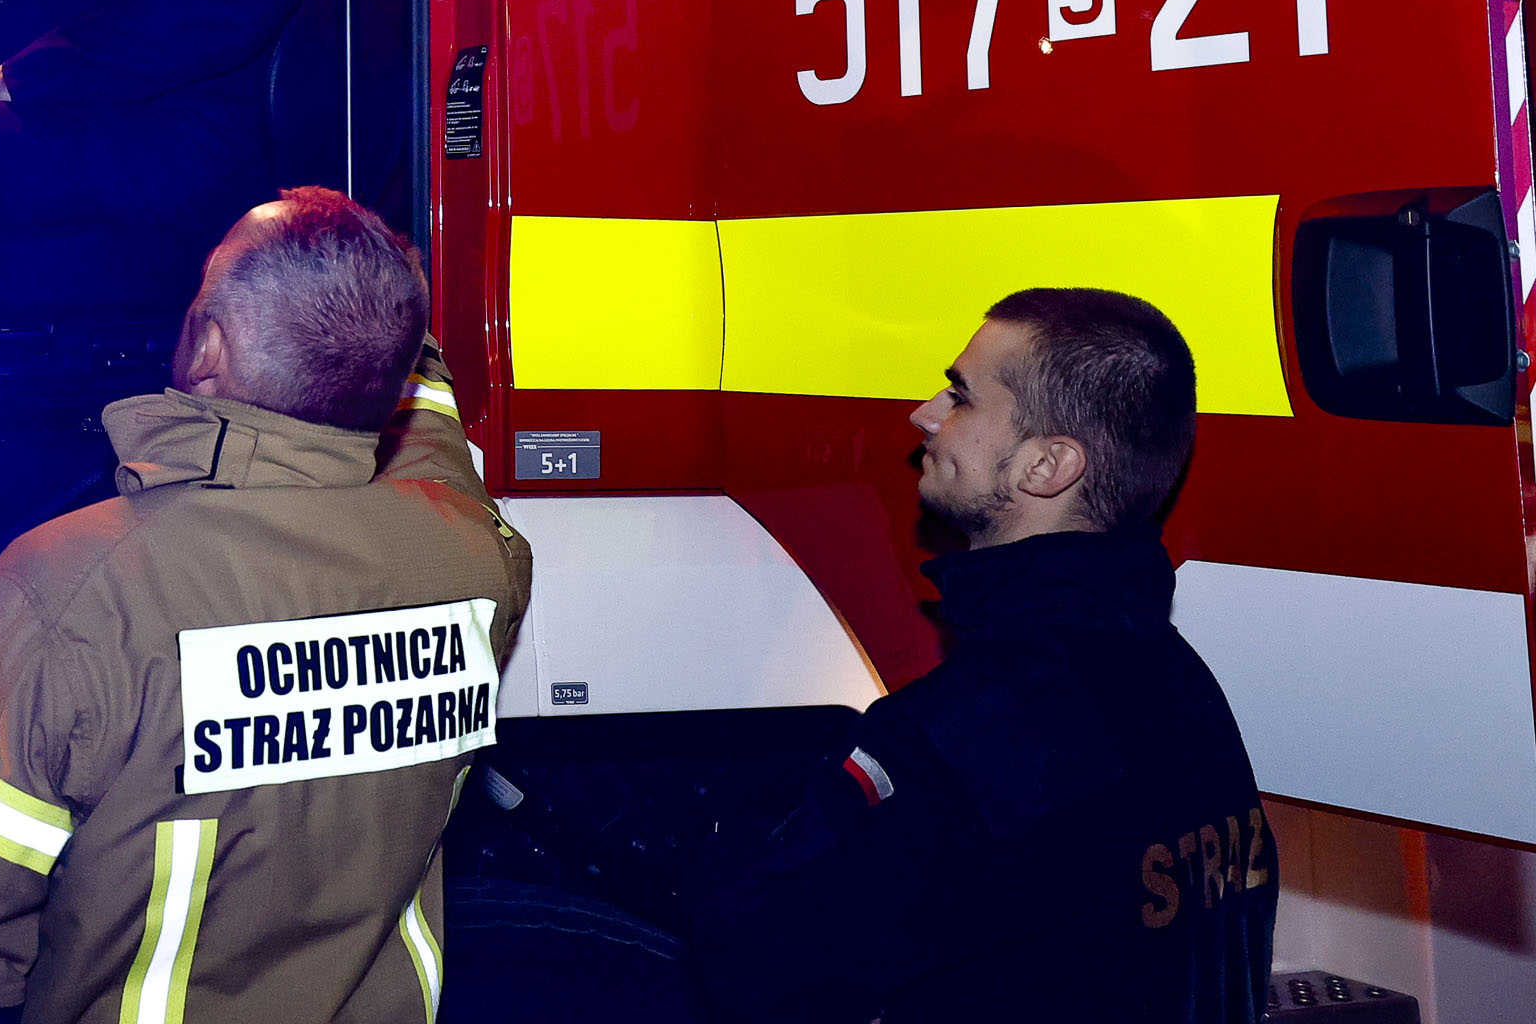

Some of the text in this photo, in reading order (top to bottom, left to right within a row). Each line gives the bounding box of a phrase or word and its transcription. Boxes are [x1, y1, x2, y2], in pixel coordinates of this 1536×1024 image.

[541, 452, 578, 474] 5+1
[236, 622, 467, 699] OCHOTNICZA
[572, 688, 585, 698] bar
